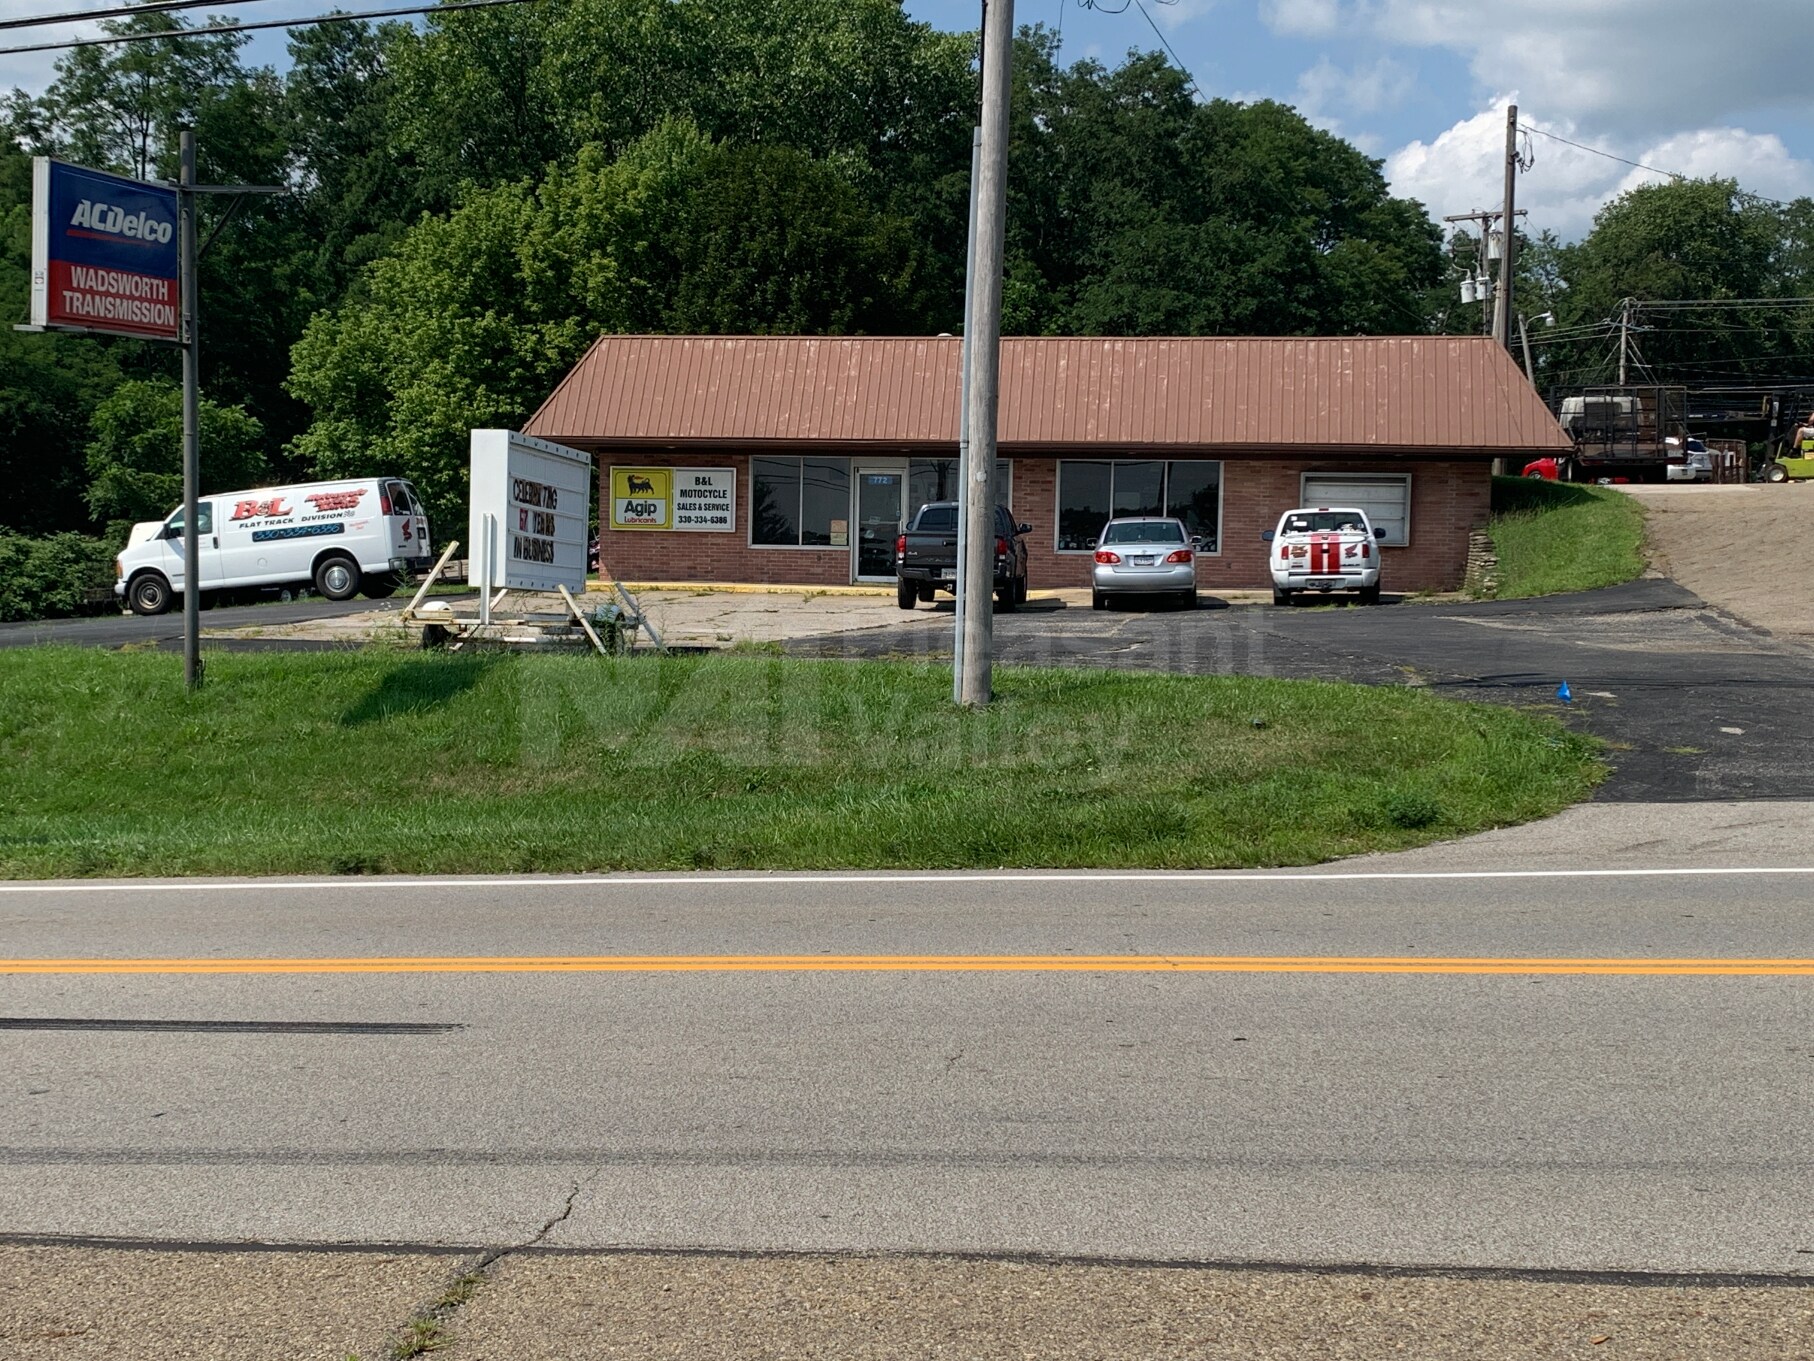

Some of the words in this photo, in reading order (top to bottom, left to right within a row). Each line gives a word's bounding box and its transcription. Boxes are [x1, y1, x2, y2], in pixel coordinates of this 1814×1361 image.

[69, 199, 173, 244] ACDelco
[70, 266, 168, 301] WADSWORTH
[62, 290, 175, 326] TRANSMISSION
[694, 476, 713, 486] B&L
[873, 476, 888, 485] 772
[513, 478, 558, 510] CELEBRATING
[679, 488, 728, 499] MOTOCYCLE
[228, 497, 294, 522] B&L
[624, 500, 657, 516] Agip
[677, 502, 697, 512] SALES
[697, 503, 703, 511] &
[703, 502, 730, 512] SERVICE
[239, 521, 262, 529] FLAT
[264, 518, 295, 526] TRACK
[300, 512, 344, 522] DIVISION
[532, 510, 556, 537] YEARS
[624, 515, 657, 524] Lubricants
